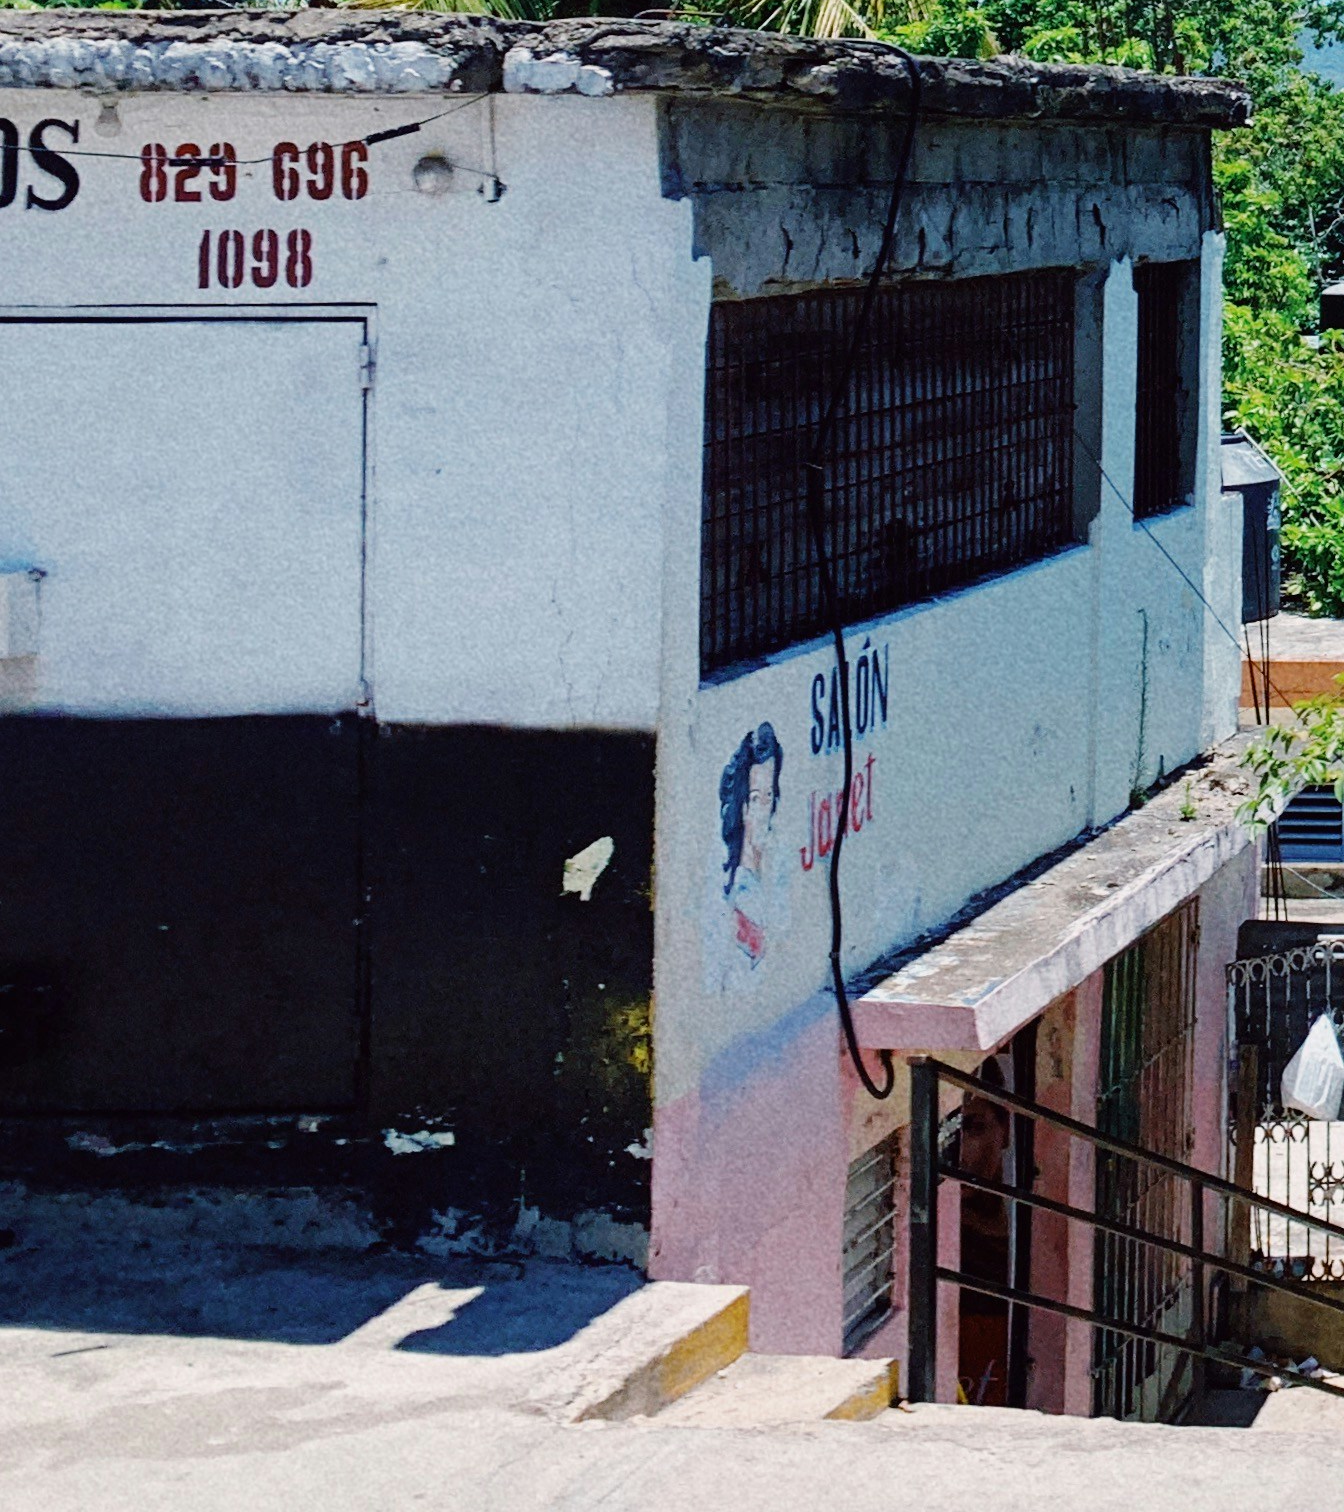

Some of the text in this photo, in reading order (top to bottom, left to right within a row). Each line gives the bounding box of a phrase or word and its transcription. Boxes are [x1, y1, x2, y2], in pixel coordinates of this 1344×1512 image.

[140, 141, 369, 203] 829 696
[198, 228, 313, 289] 1098
[811, 636, 889, 755] SAÓN
